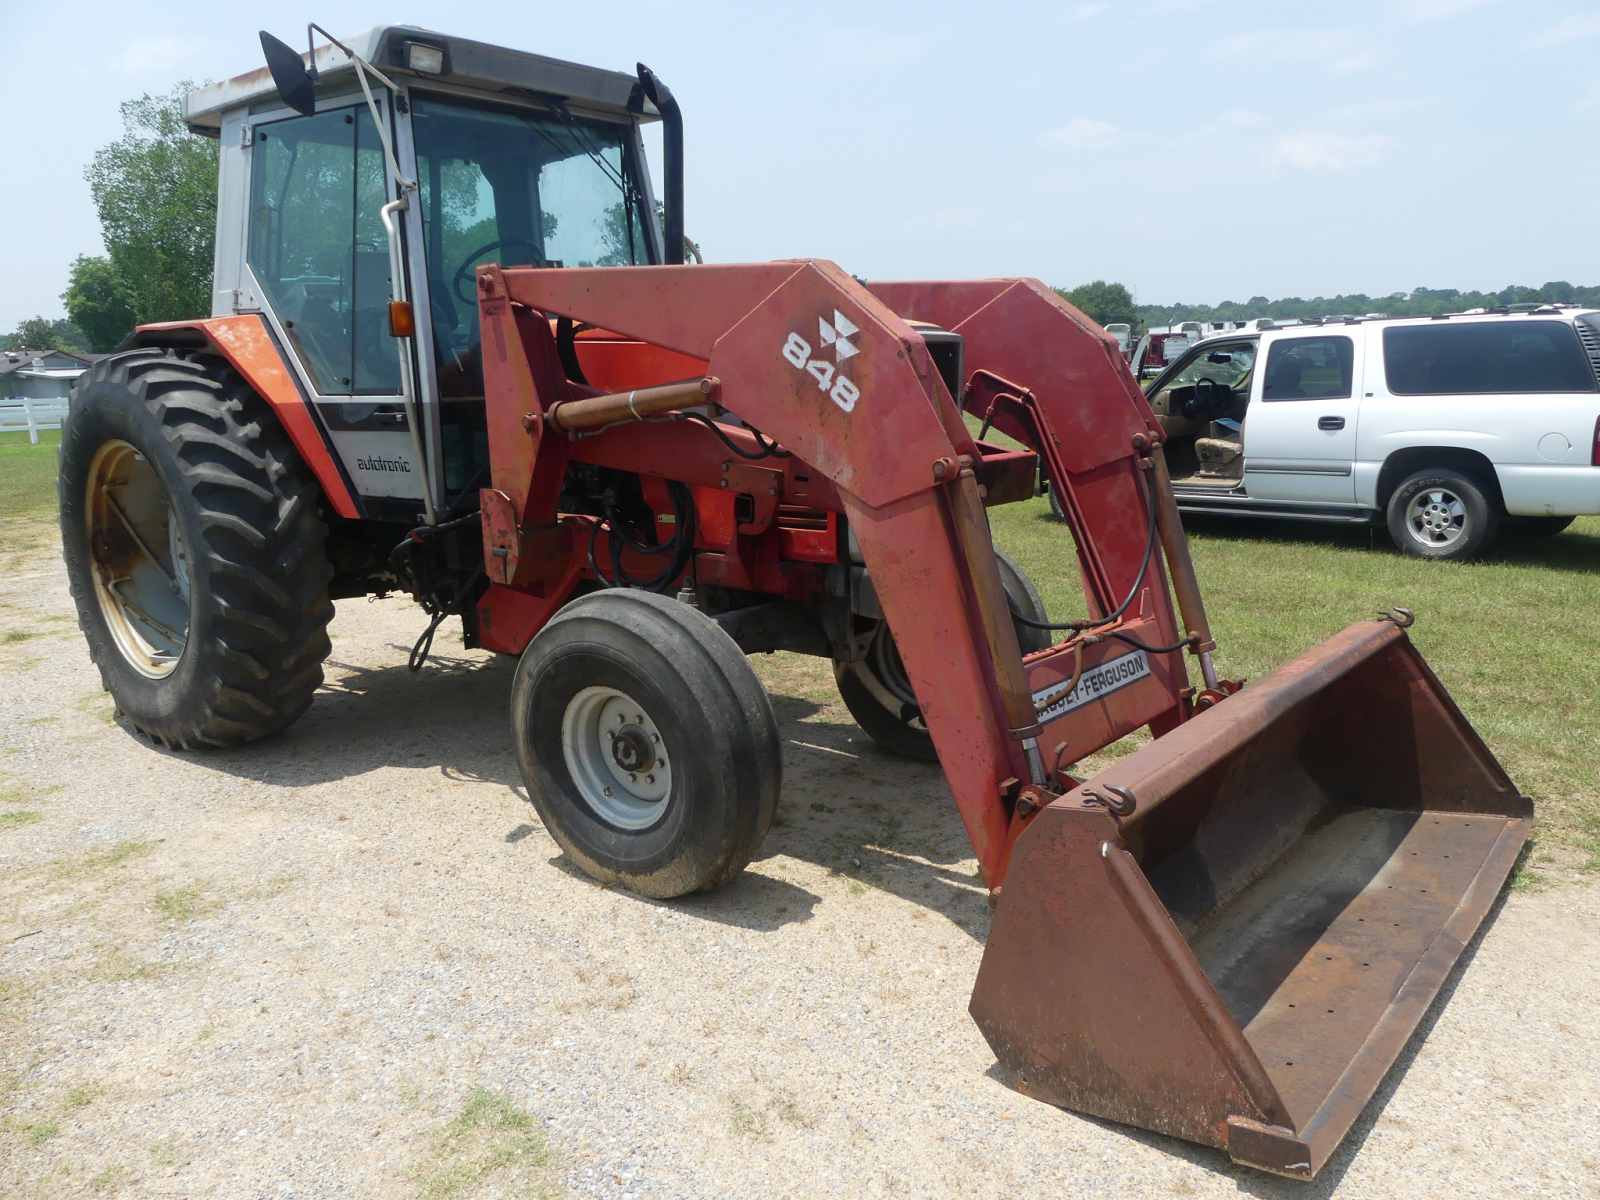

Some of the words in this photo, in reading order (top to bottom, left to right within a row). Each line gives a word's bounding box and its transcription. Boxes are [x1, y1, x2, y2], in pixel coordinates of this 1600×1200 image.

[782, 331, 860, 412] 848
[357, 456, 411, 473] autotronic
[1036, 655, 1144, 717] SEY-FERGUSON
